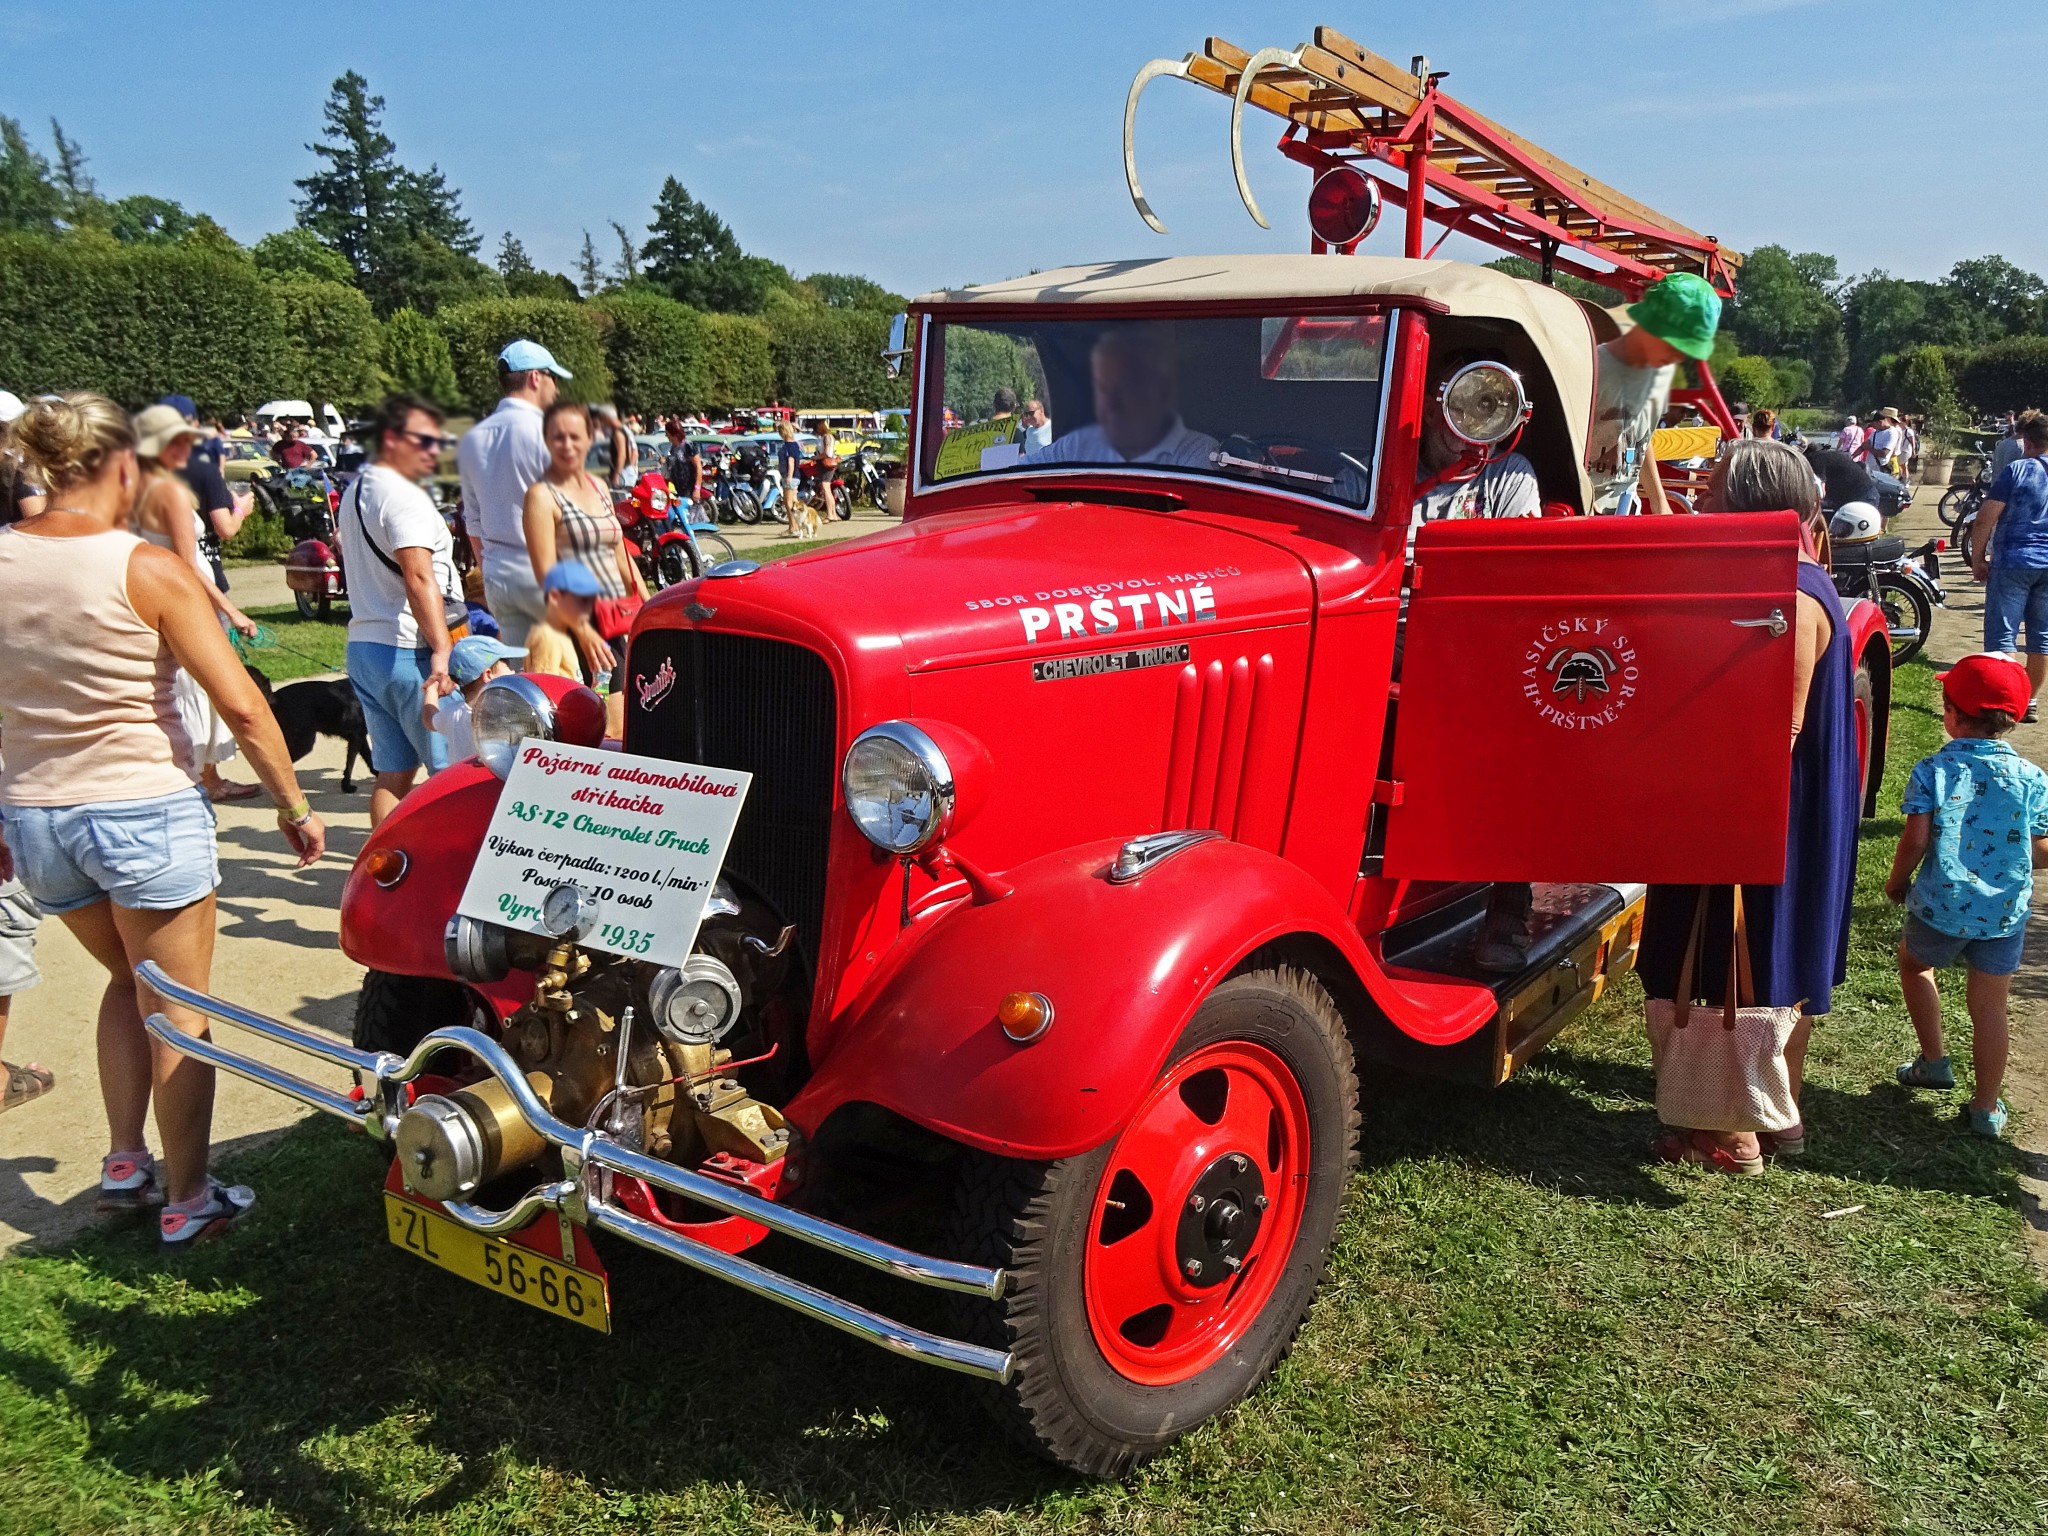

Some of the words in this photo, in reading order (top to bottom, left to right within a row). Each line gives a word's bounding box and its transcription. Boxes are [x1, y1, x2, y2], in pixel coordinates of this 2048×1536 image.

[965, 594, 1029, 611] SBOR
[1034, 578, 1162, 602] DOBROVOL.
[1169, 565, 1242, 583] HASIČŮ
[1018, 583, 1217, 644] PRŠTNÉ
[1042, 653, 1128, 680] CHEVROLET
[1137, 646, 1182, 667] TRUCK
[1522, 617, 1608, 697] HASIČSKÝ
[1612, 635, 1639, 698] SBOR
[1538, 703, 1619, 730] PRŠTNÉ
[522, 747, 603, 776] Požární
[607, 766, 737, 798] automobilová
[571, 787, 664, 816] stříkačka
[573, 815, 654, 846] Chevrolet
[655, 830, 711, 856] Truck
[488, 835, 535, 859] Výkon
[537, 847, 611, 876] čerpadla:
[612, 866, 651, 883] 1200
[591, 885, 614, 900] 10
[617, 893, 654, 910] osob
[600, 923, 656, 955] 1935
[402, 1207, 439, 1259] ZL
[485, 1244, 584, 1316] 56-66
